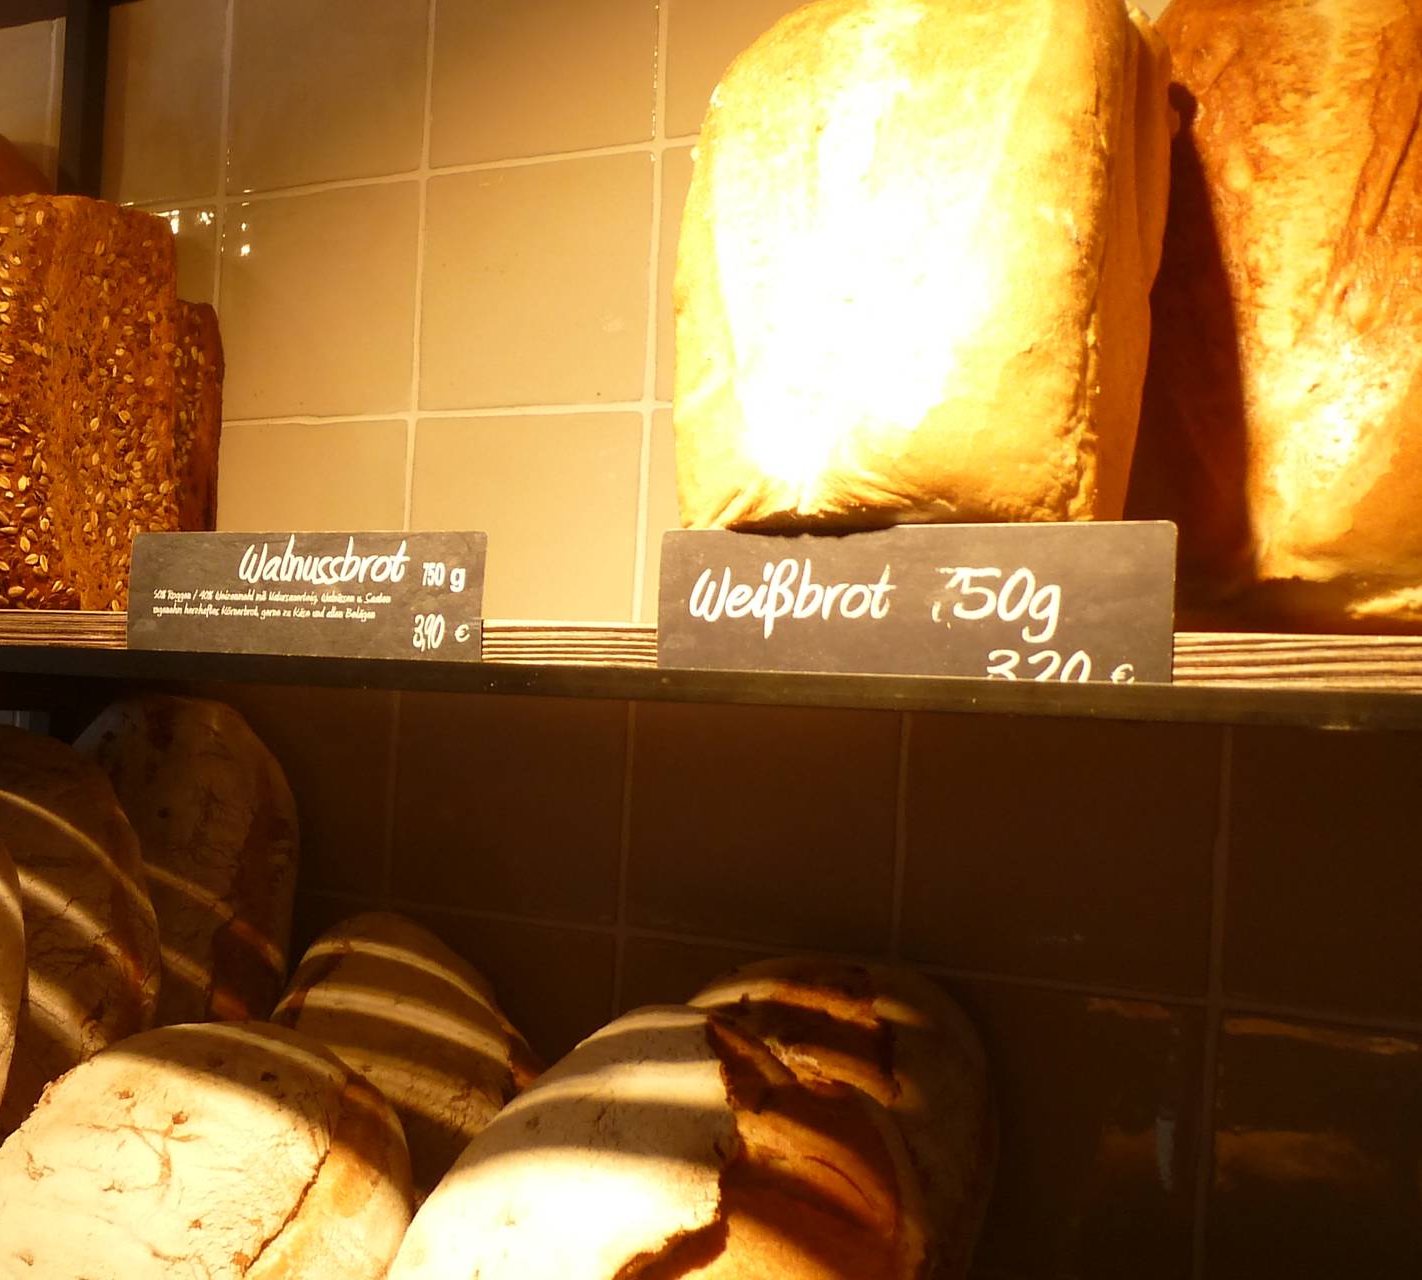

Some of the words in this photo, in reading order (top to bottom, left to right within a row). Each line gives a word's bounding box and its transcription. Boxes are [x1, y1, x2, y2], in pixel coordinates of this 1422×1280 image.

[238, 534, 411, 585] Walnussbrot
[422, 562, 446, 586] 750
[450, 567, 466, 593] g
[688, 558, 897, 640] Weißbrot
[412, 613, 446, 652] 3,90
[454, 624, 470, 643] €
